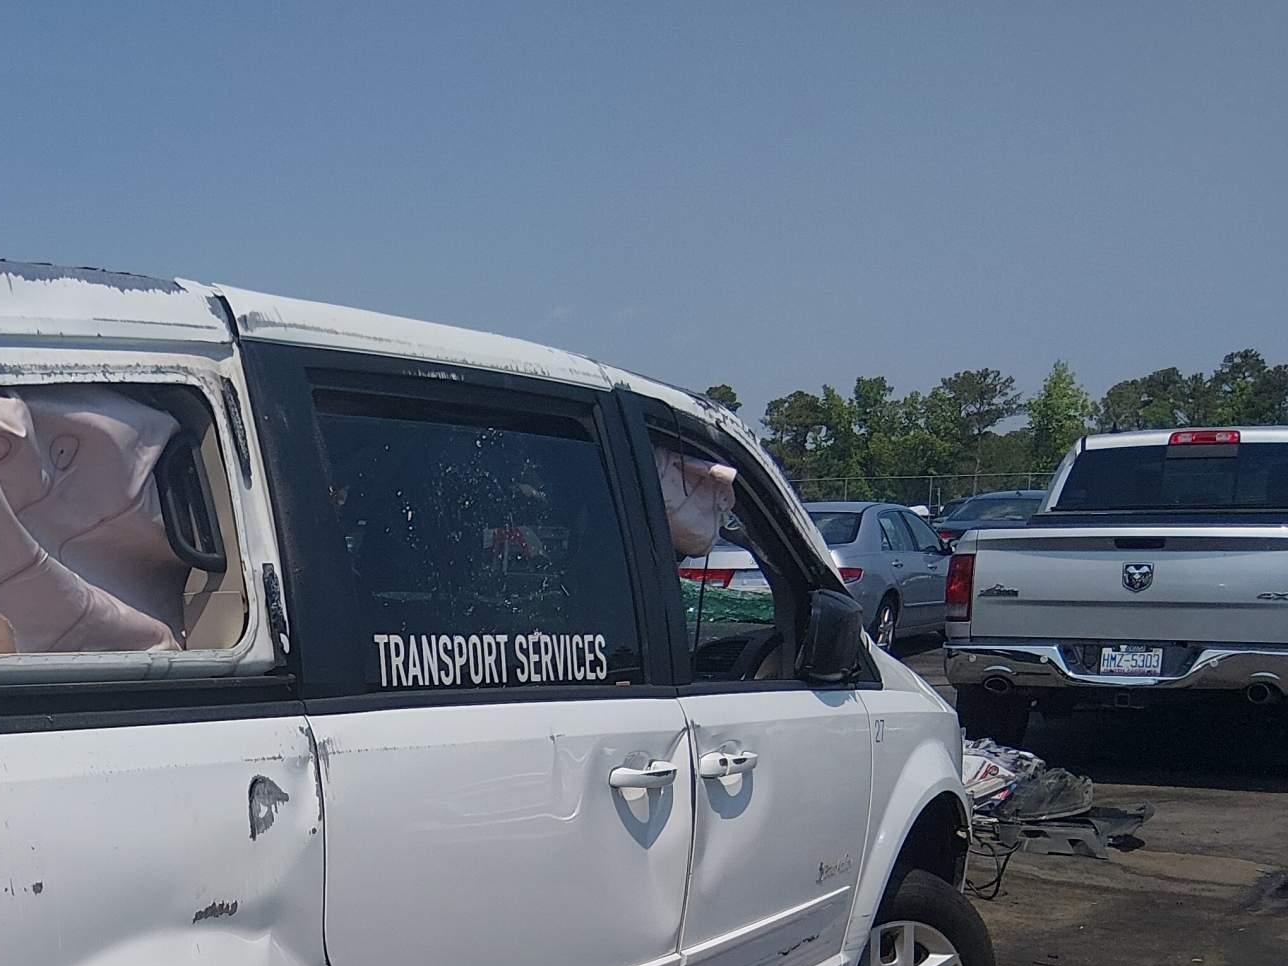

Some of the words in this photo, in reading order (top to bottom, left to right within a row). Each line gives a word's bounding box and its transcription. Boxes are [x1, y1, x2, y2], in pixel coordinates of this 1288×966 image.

[373, 633, 508, 687] TRANSPORT
[514, 633, 608, 683] SERVICES
[1102, 652, 1160, 669] HMZ-5303
[874, 719, 885, 743] 27
